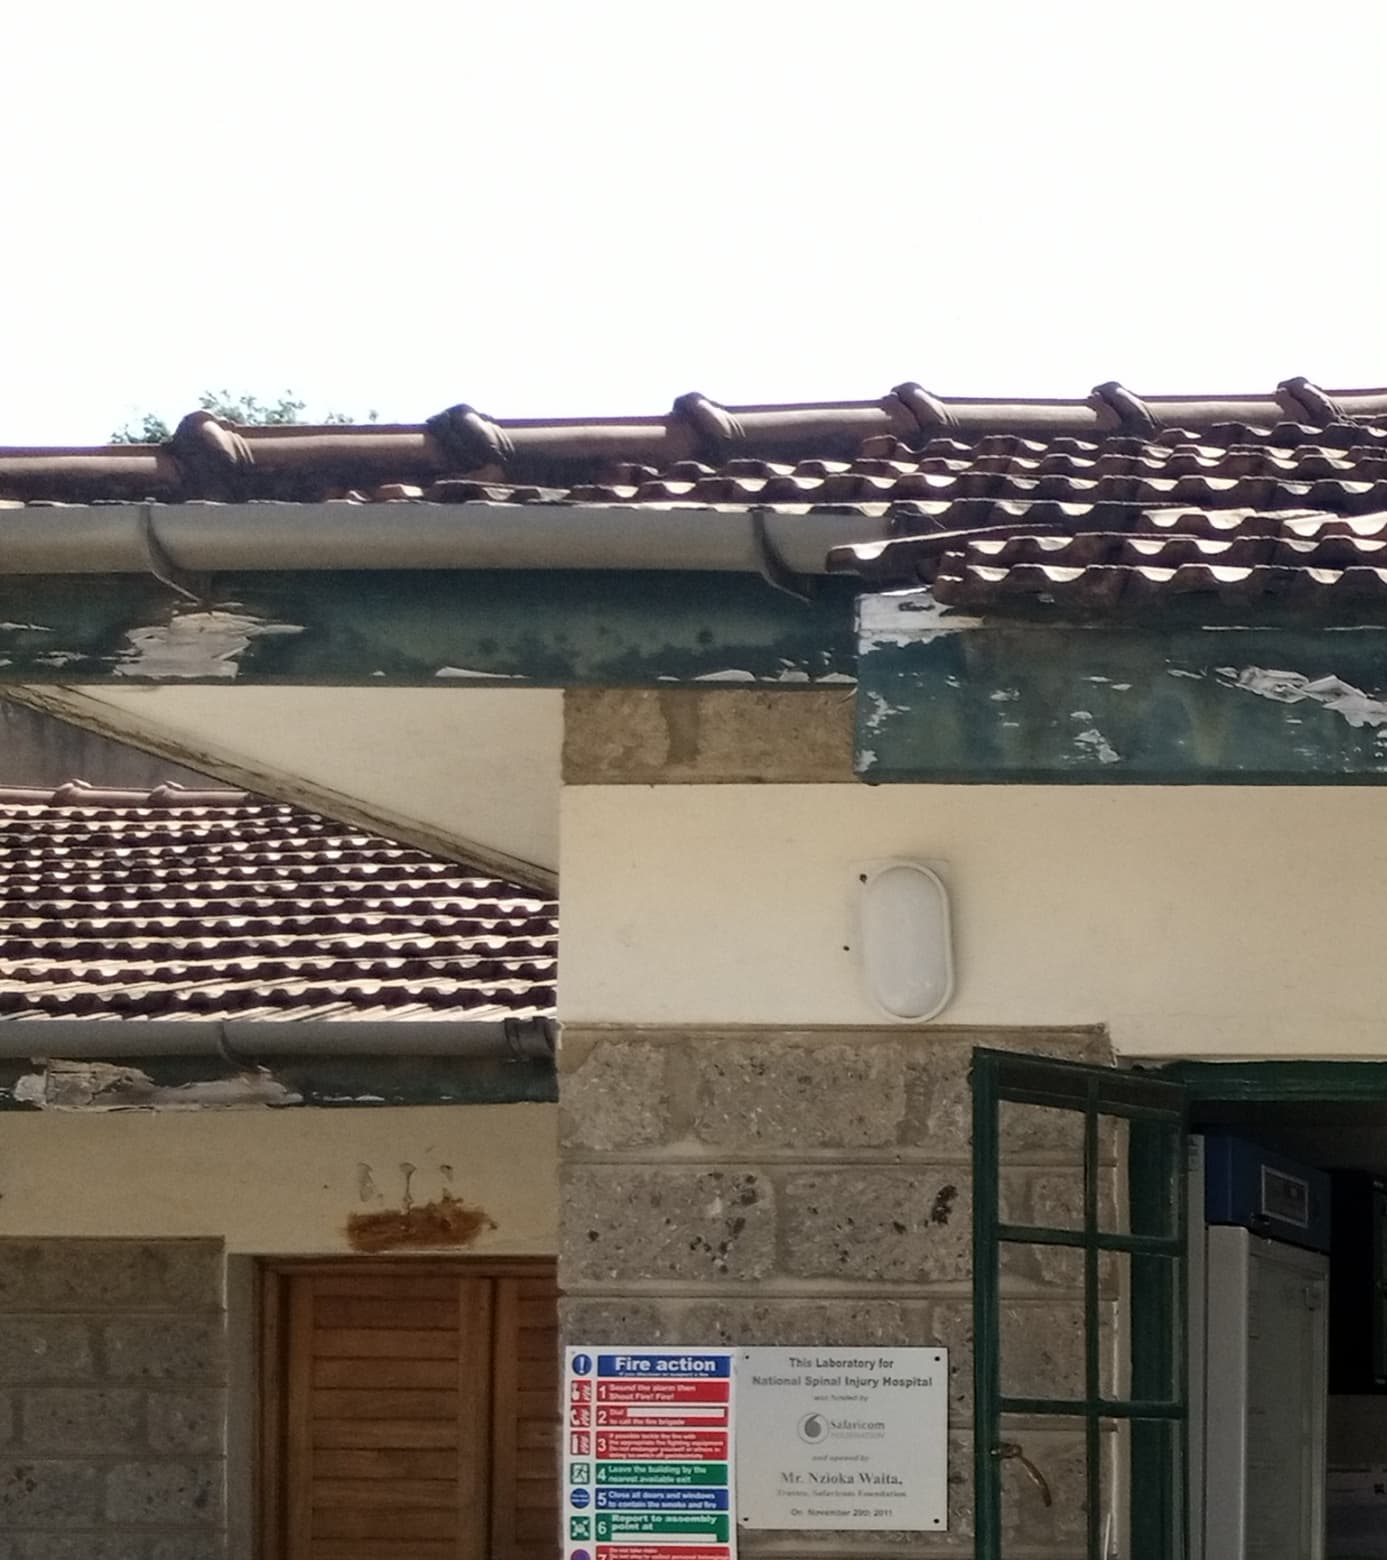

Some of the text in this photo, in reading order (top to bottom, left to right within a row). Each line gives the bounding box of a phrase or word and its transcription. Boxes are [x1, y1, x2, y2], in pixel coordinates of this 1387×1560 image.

[615, 1357, 716, 1371] Fire action
[789, 1357, 894, 1370] This Laboratory for
[751, 1376, 933, 1388] National Spinal Injury Hospital
[598, 1385, 606, 1399] 1
[598, 1411, 607, 1424] 2
[598, 1438, 607, 1452] 3
[597, 1467, 606, 1482] 4
[808, 1472, 855, 1485] Nzioka
[598, 1492, 607, 1506] 5
[612, 1514, 717, 1524] Report to assembly
[598, 1521, 607, 1535] 6
[612, 1522, 653, 1531] point at
